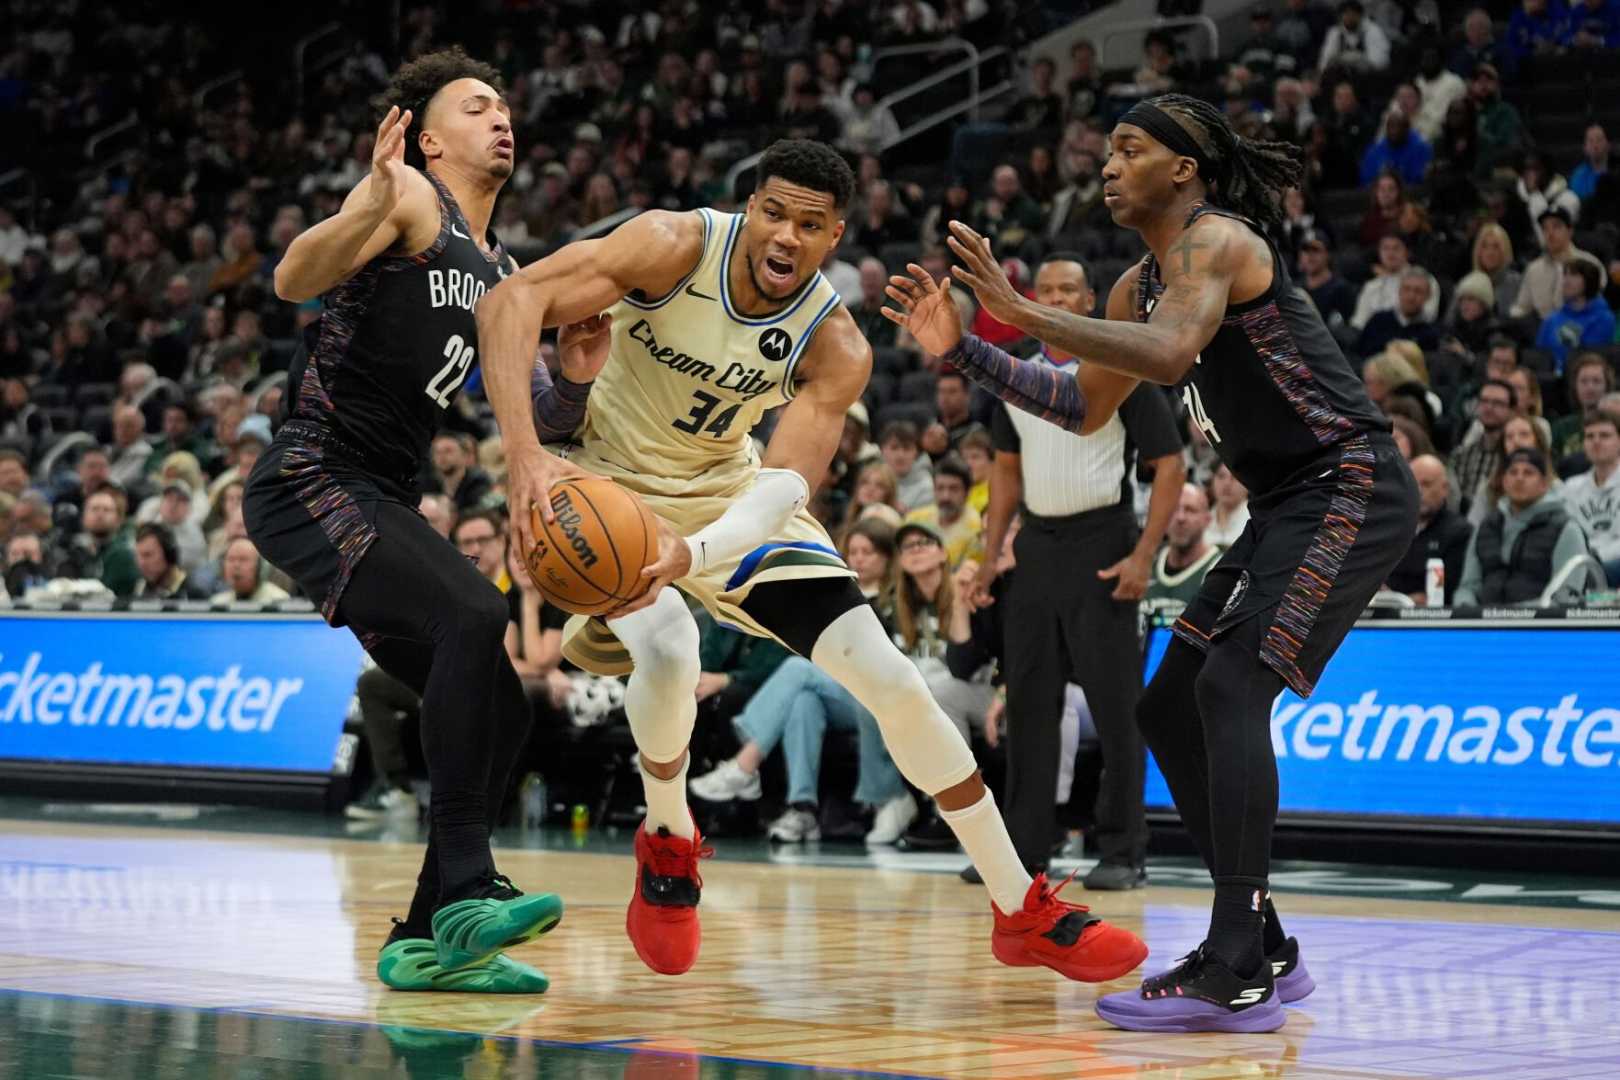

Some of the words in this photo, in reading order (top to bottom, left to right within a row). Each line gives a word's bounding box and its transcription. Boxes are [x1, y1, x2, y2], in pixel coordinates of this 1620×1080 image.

[428, 268, 489, 314] BROO
[425, 334, 475, 409] 22
[629, 319, 716, 382] Cream
[715, 362, 777, 402] City
[672, 390, 743, 438] 34
[551, 489, 598, 570] Wilson
[0, 651, 303, 732] cketmaster
[1270, 689, 1620, 767] ketmaste
